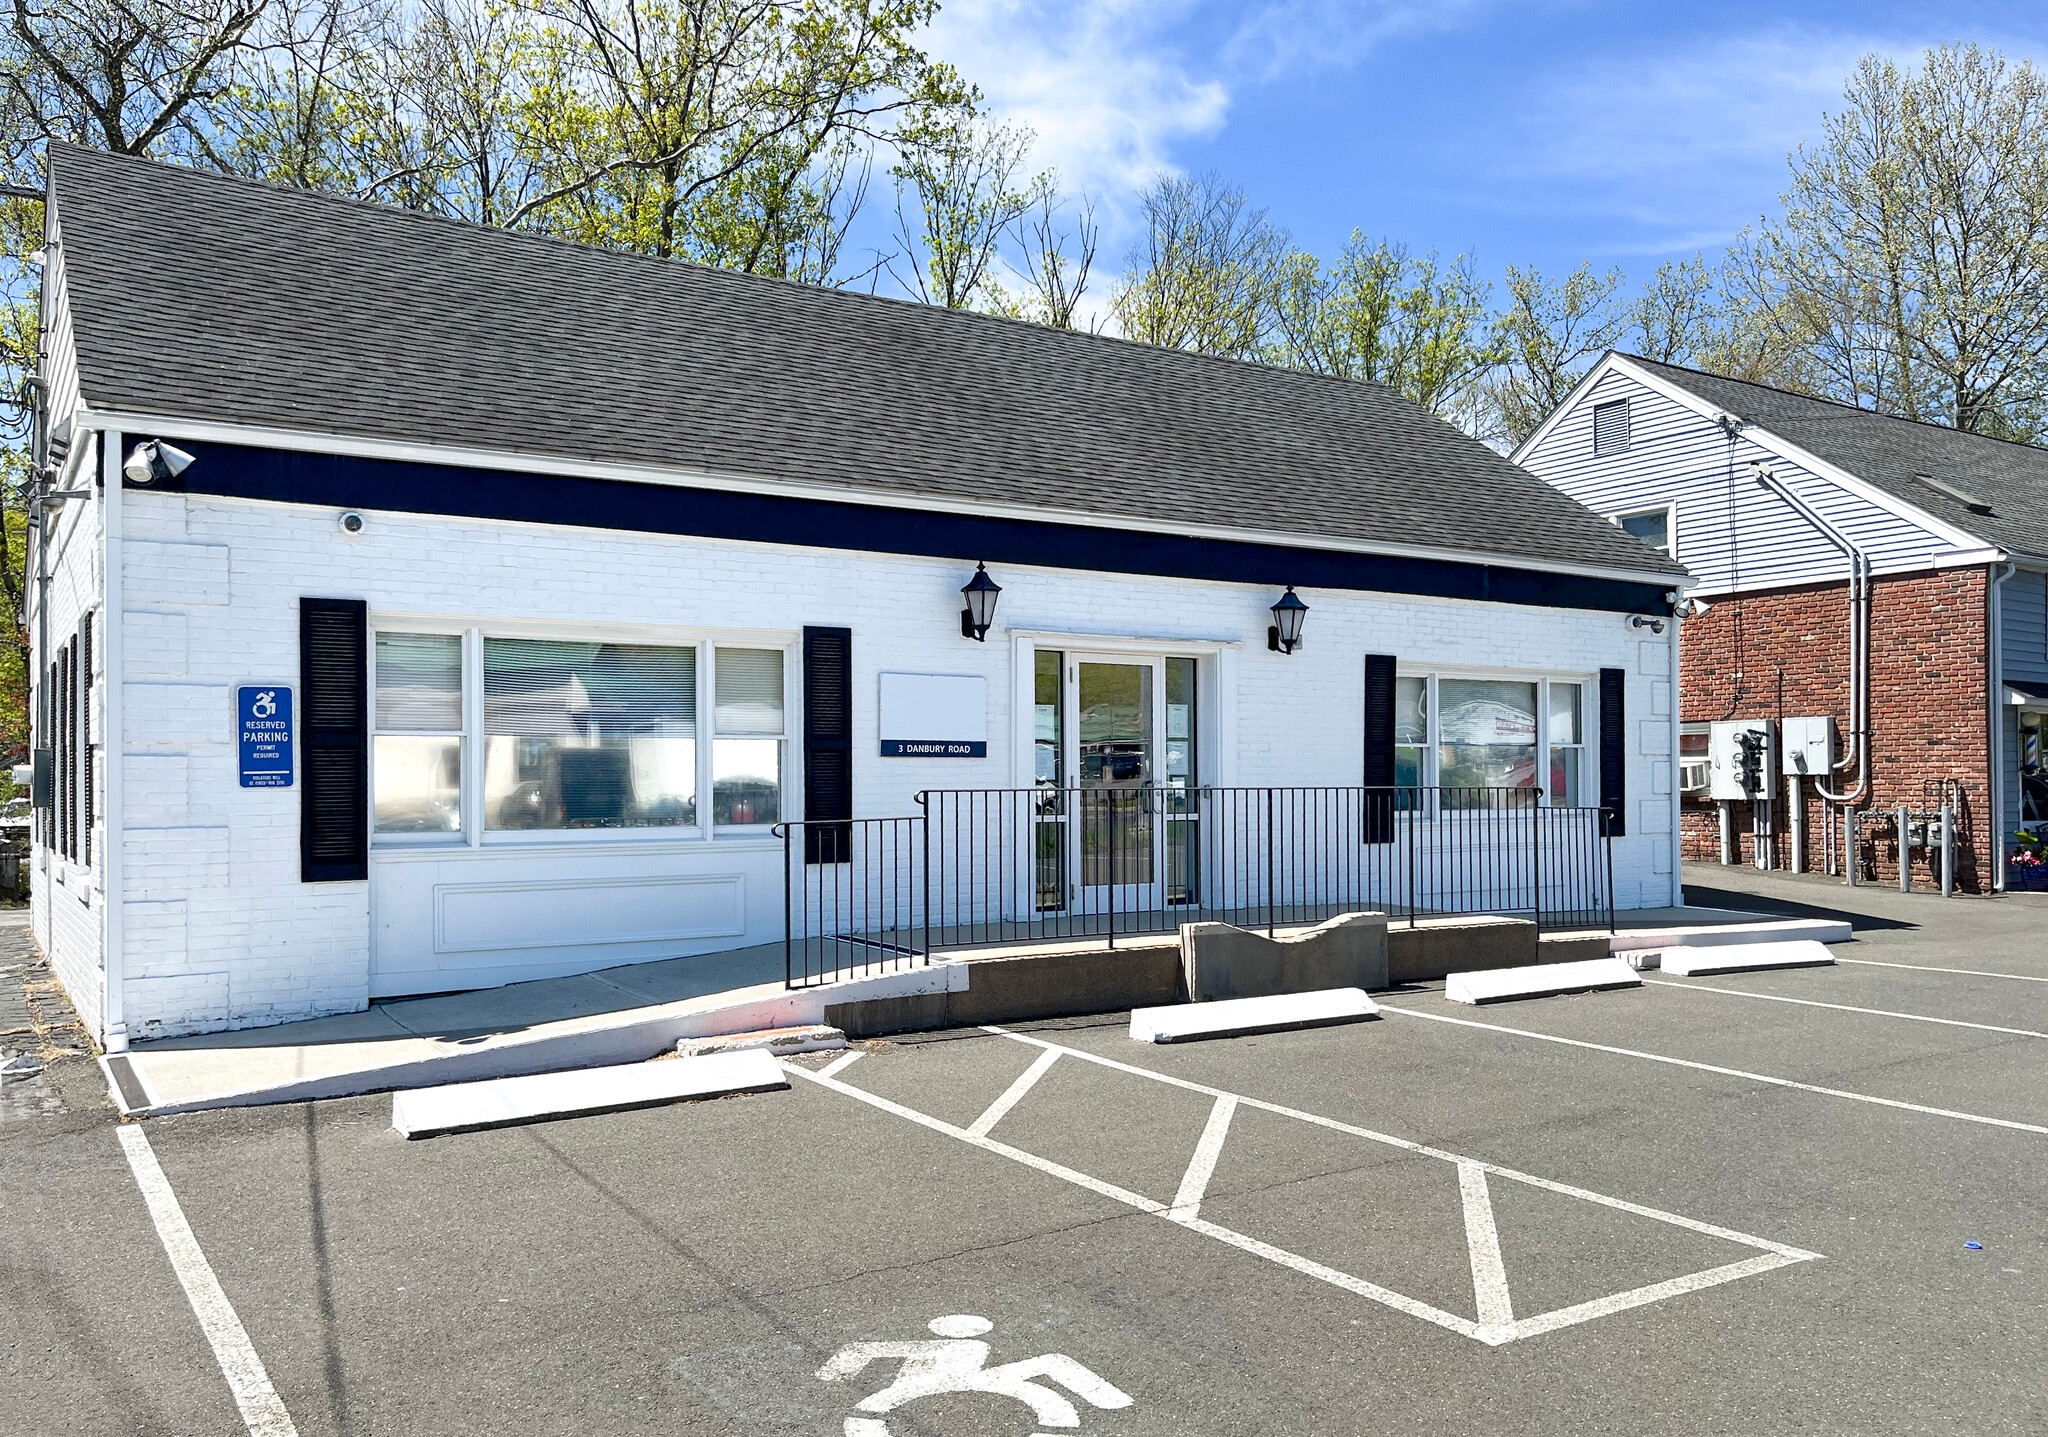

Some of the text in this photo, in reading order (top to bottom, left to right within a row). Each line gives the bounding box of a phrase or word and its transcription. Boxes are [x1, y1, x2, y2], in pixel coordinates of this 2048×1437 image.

[246, 721, 286, 729] RESERVED
[243, 732, 288, 742] PARKING
[898, 744, 971, 754] 3 DANBURY ROAD
